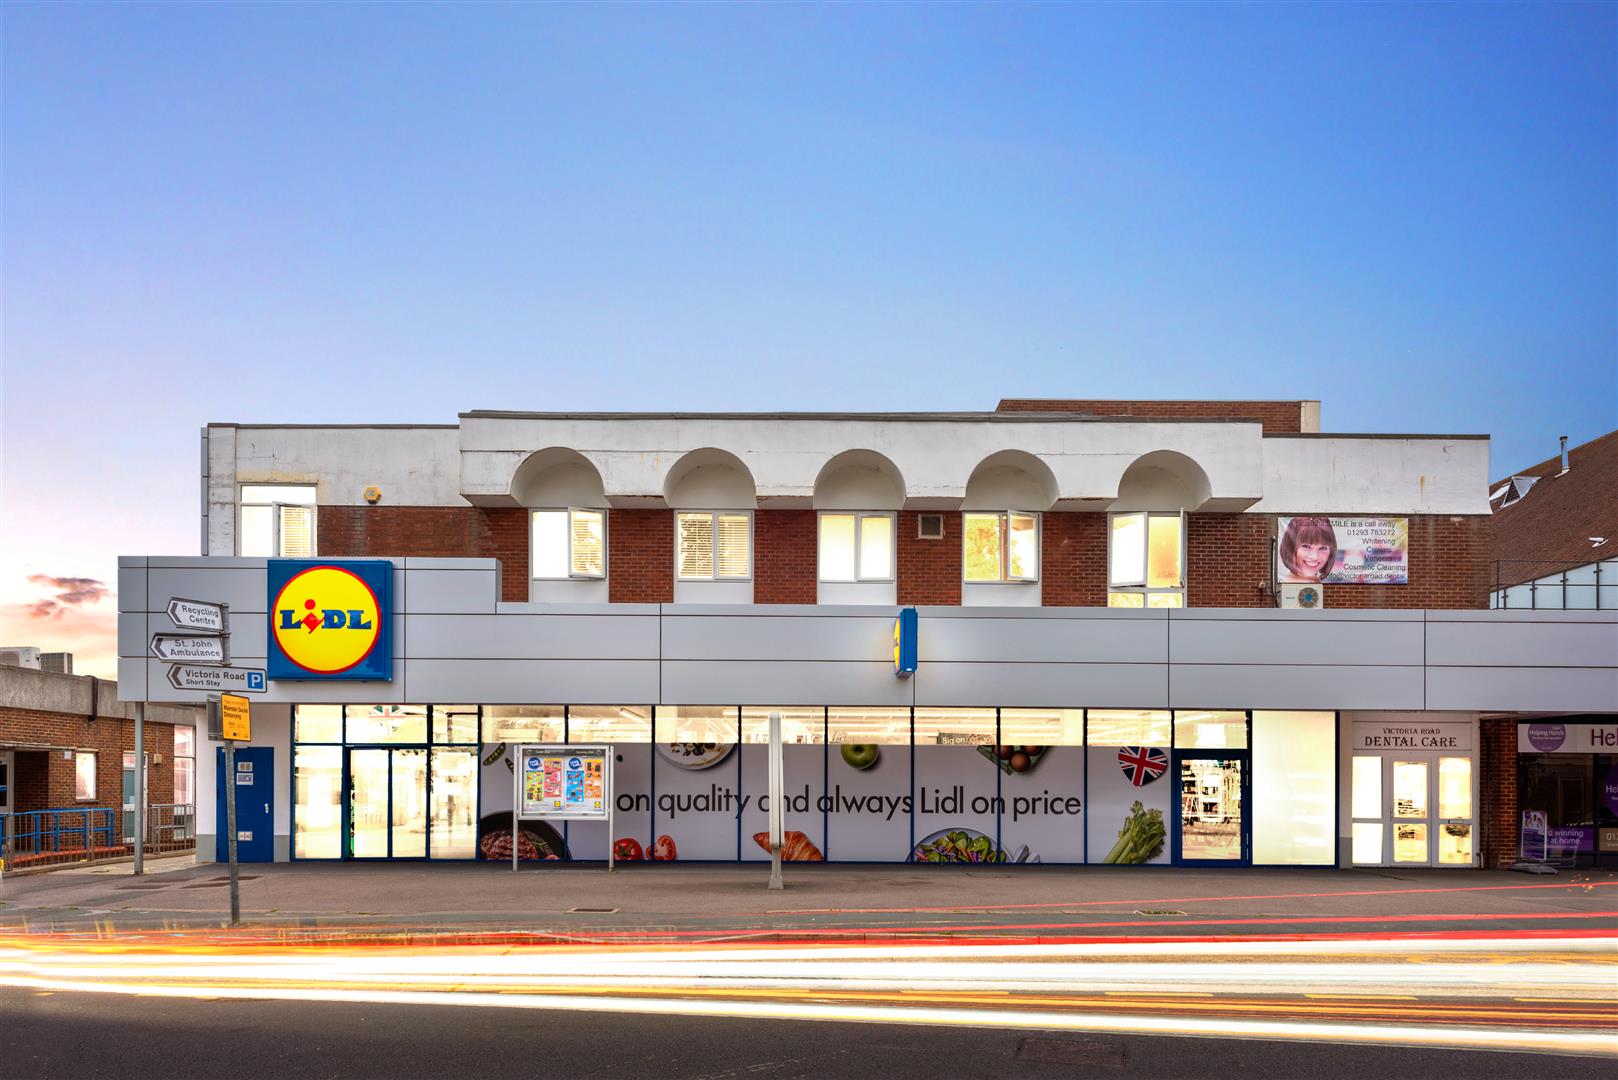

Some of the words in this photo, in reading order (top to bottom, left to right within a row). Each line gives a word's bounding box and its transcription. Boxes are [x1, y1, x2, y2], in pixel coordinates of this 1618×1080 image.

[1377, 521, 1396, 529] away
[1376, 563, 1406, 572] Cleaning
[1326, 572, 1405, 580] fo@victoriaroad.dental
[181, 604, 220, 618] Recycling
[188, 614, 216, 626] Centre
[174, 639, 189, 648] St.
[191, 639, 213, 648] John
[170, 648, 221, 657] Ambulance
[185, 669, 220, 679] Victoria
[223, 672, 245, 680] Road
[1383, 727, 1418, 735] VICTORIA
[1364, 736, 1417, 747] DENTAL
[1421, 737, 1457, 747] CARE
[616, 793, 650, 812] on
[658, 783, 751, 819] quality
[757, 785, 810, 813] and
[816, 785, 912, 821] always
[920, 785, 964, 814] Lidl
[971, 795, 1005, 815] on
[1013, 790, 1081, 822] price
[1554, 830, 1584, 838] winning
[1559, 837, 1581, 845] home
